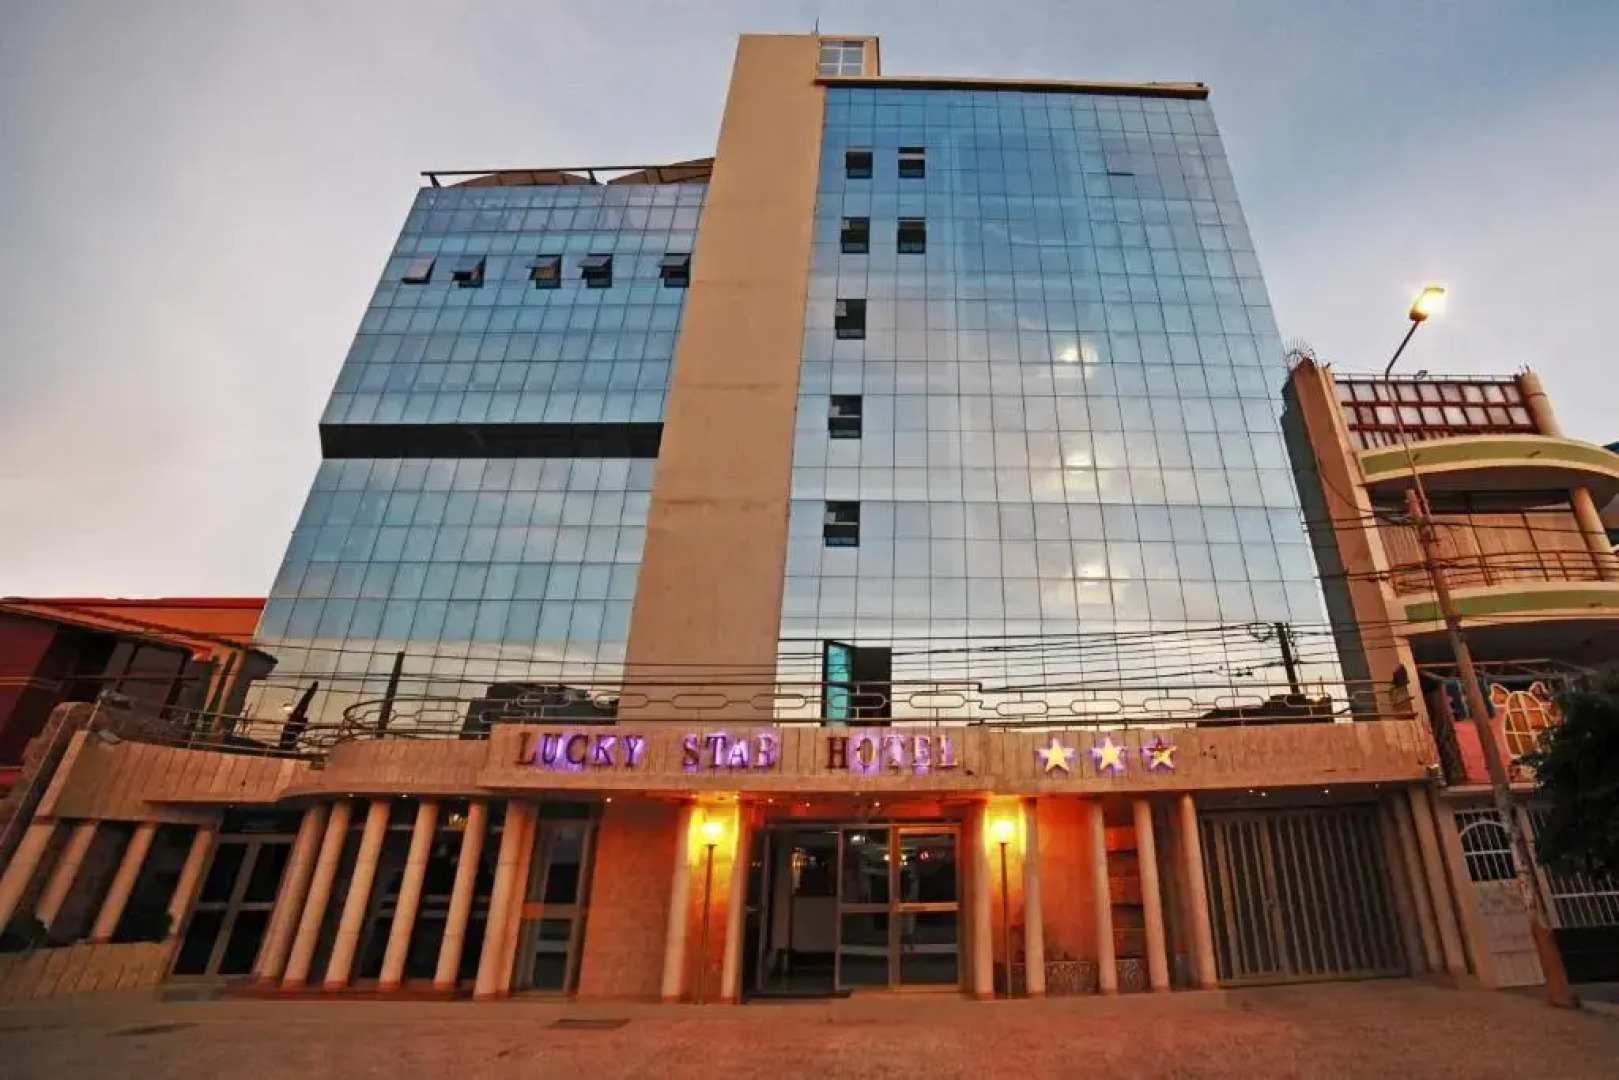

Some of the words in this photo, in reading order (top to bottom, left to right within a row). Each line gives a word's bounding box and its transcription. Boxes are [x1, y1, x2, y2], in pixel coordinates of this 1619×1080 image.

[514, 731, 645, 768] LUCKY
[682, 732, 777, 769] STAR
[825, 734, 958, 771] HOTEL
